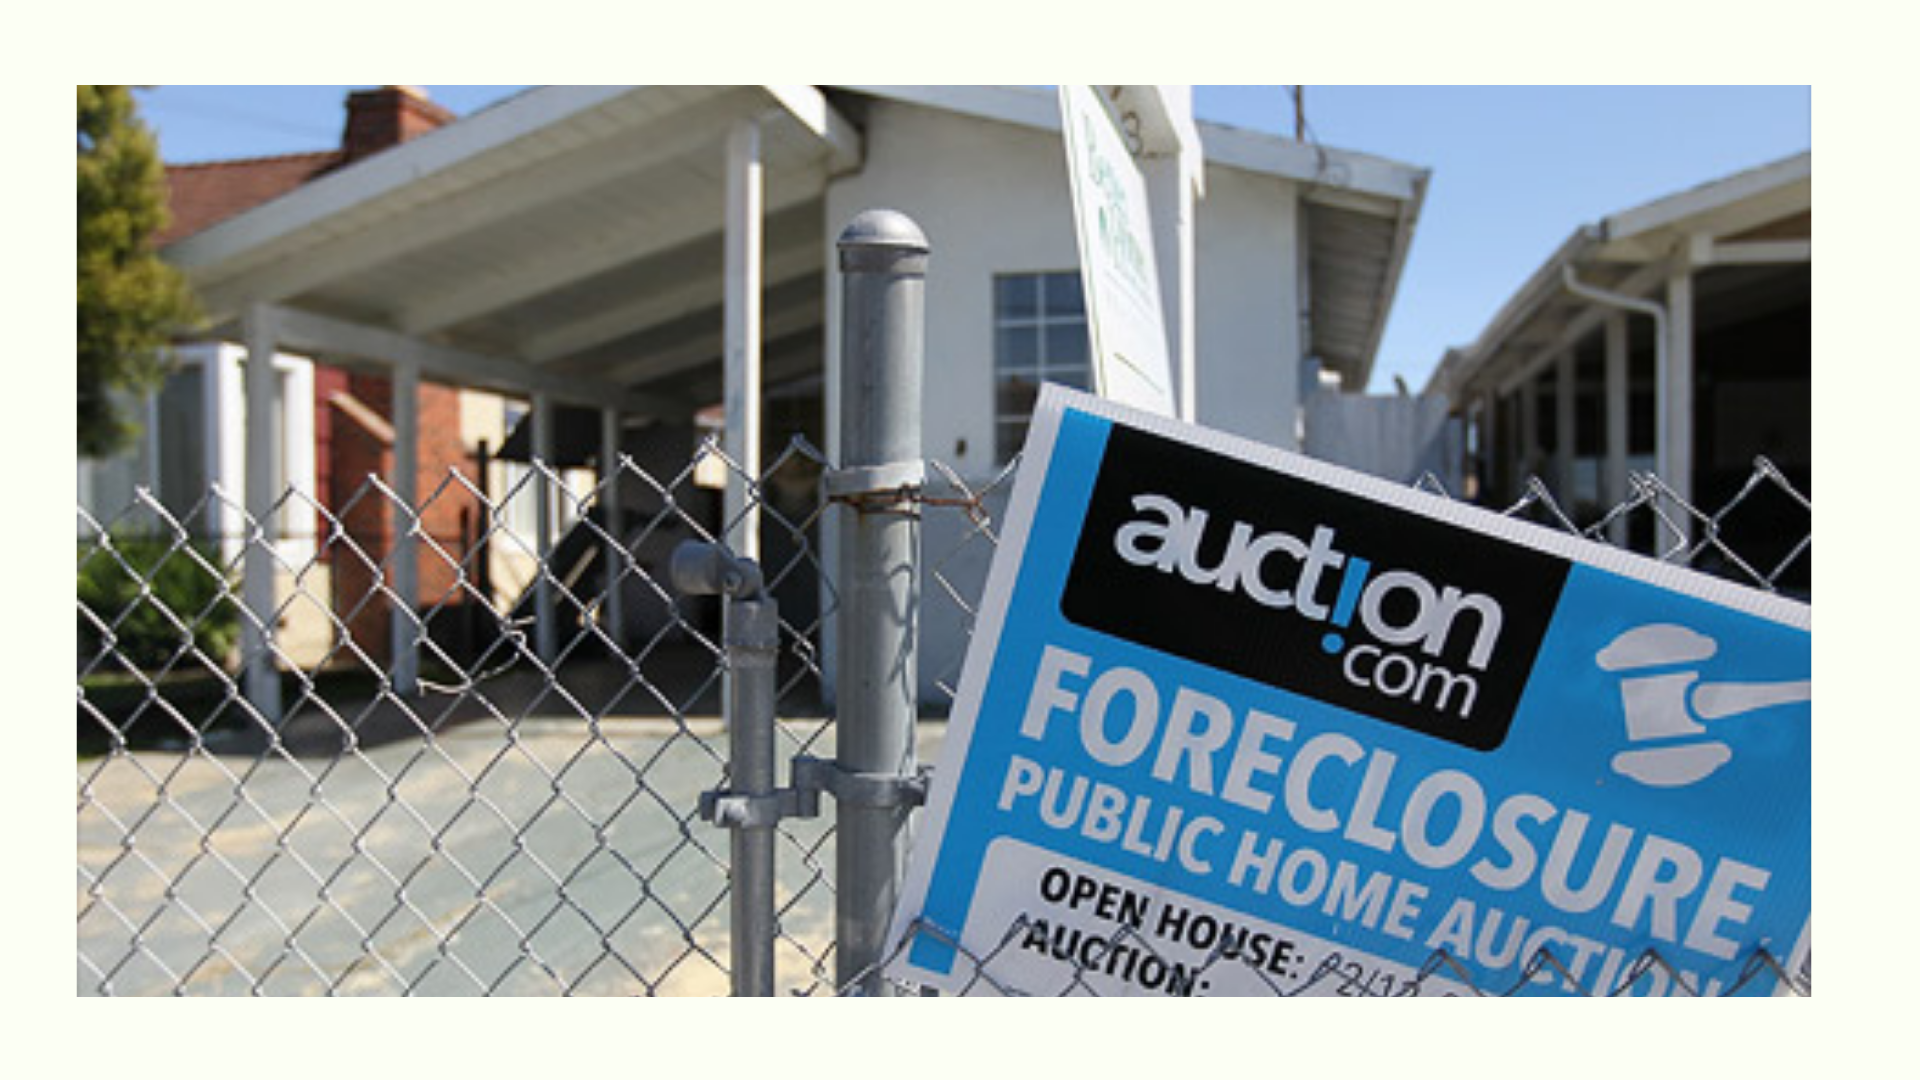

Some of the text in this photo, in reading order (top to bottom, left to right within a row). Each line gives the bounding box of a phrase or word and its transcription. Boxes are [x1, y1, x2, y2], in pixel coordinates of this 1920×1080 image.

[997, 755, 1226, 874] PUBLIC
[1227, 831, 1430, 940] HOME
[1019, 644, 1772, 960] FORECLOSURE
[1040, 867, 1305, 980] OPEN HOUSE:
